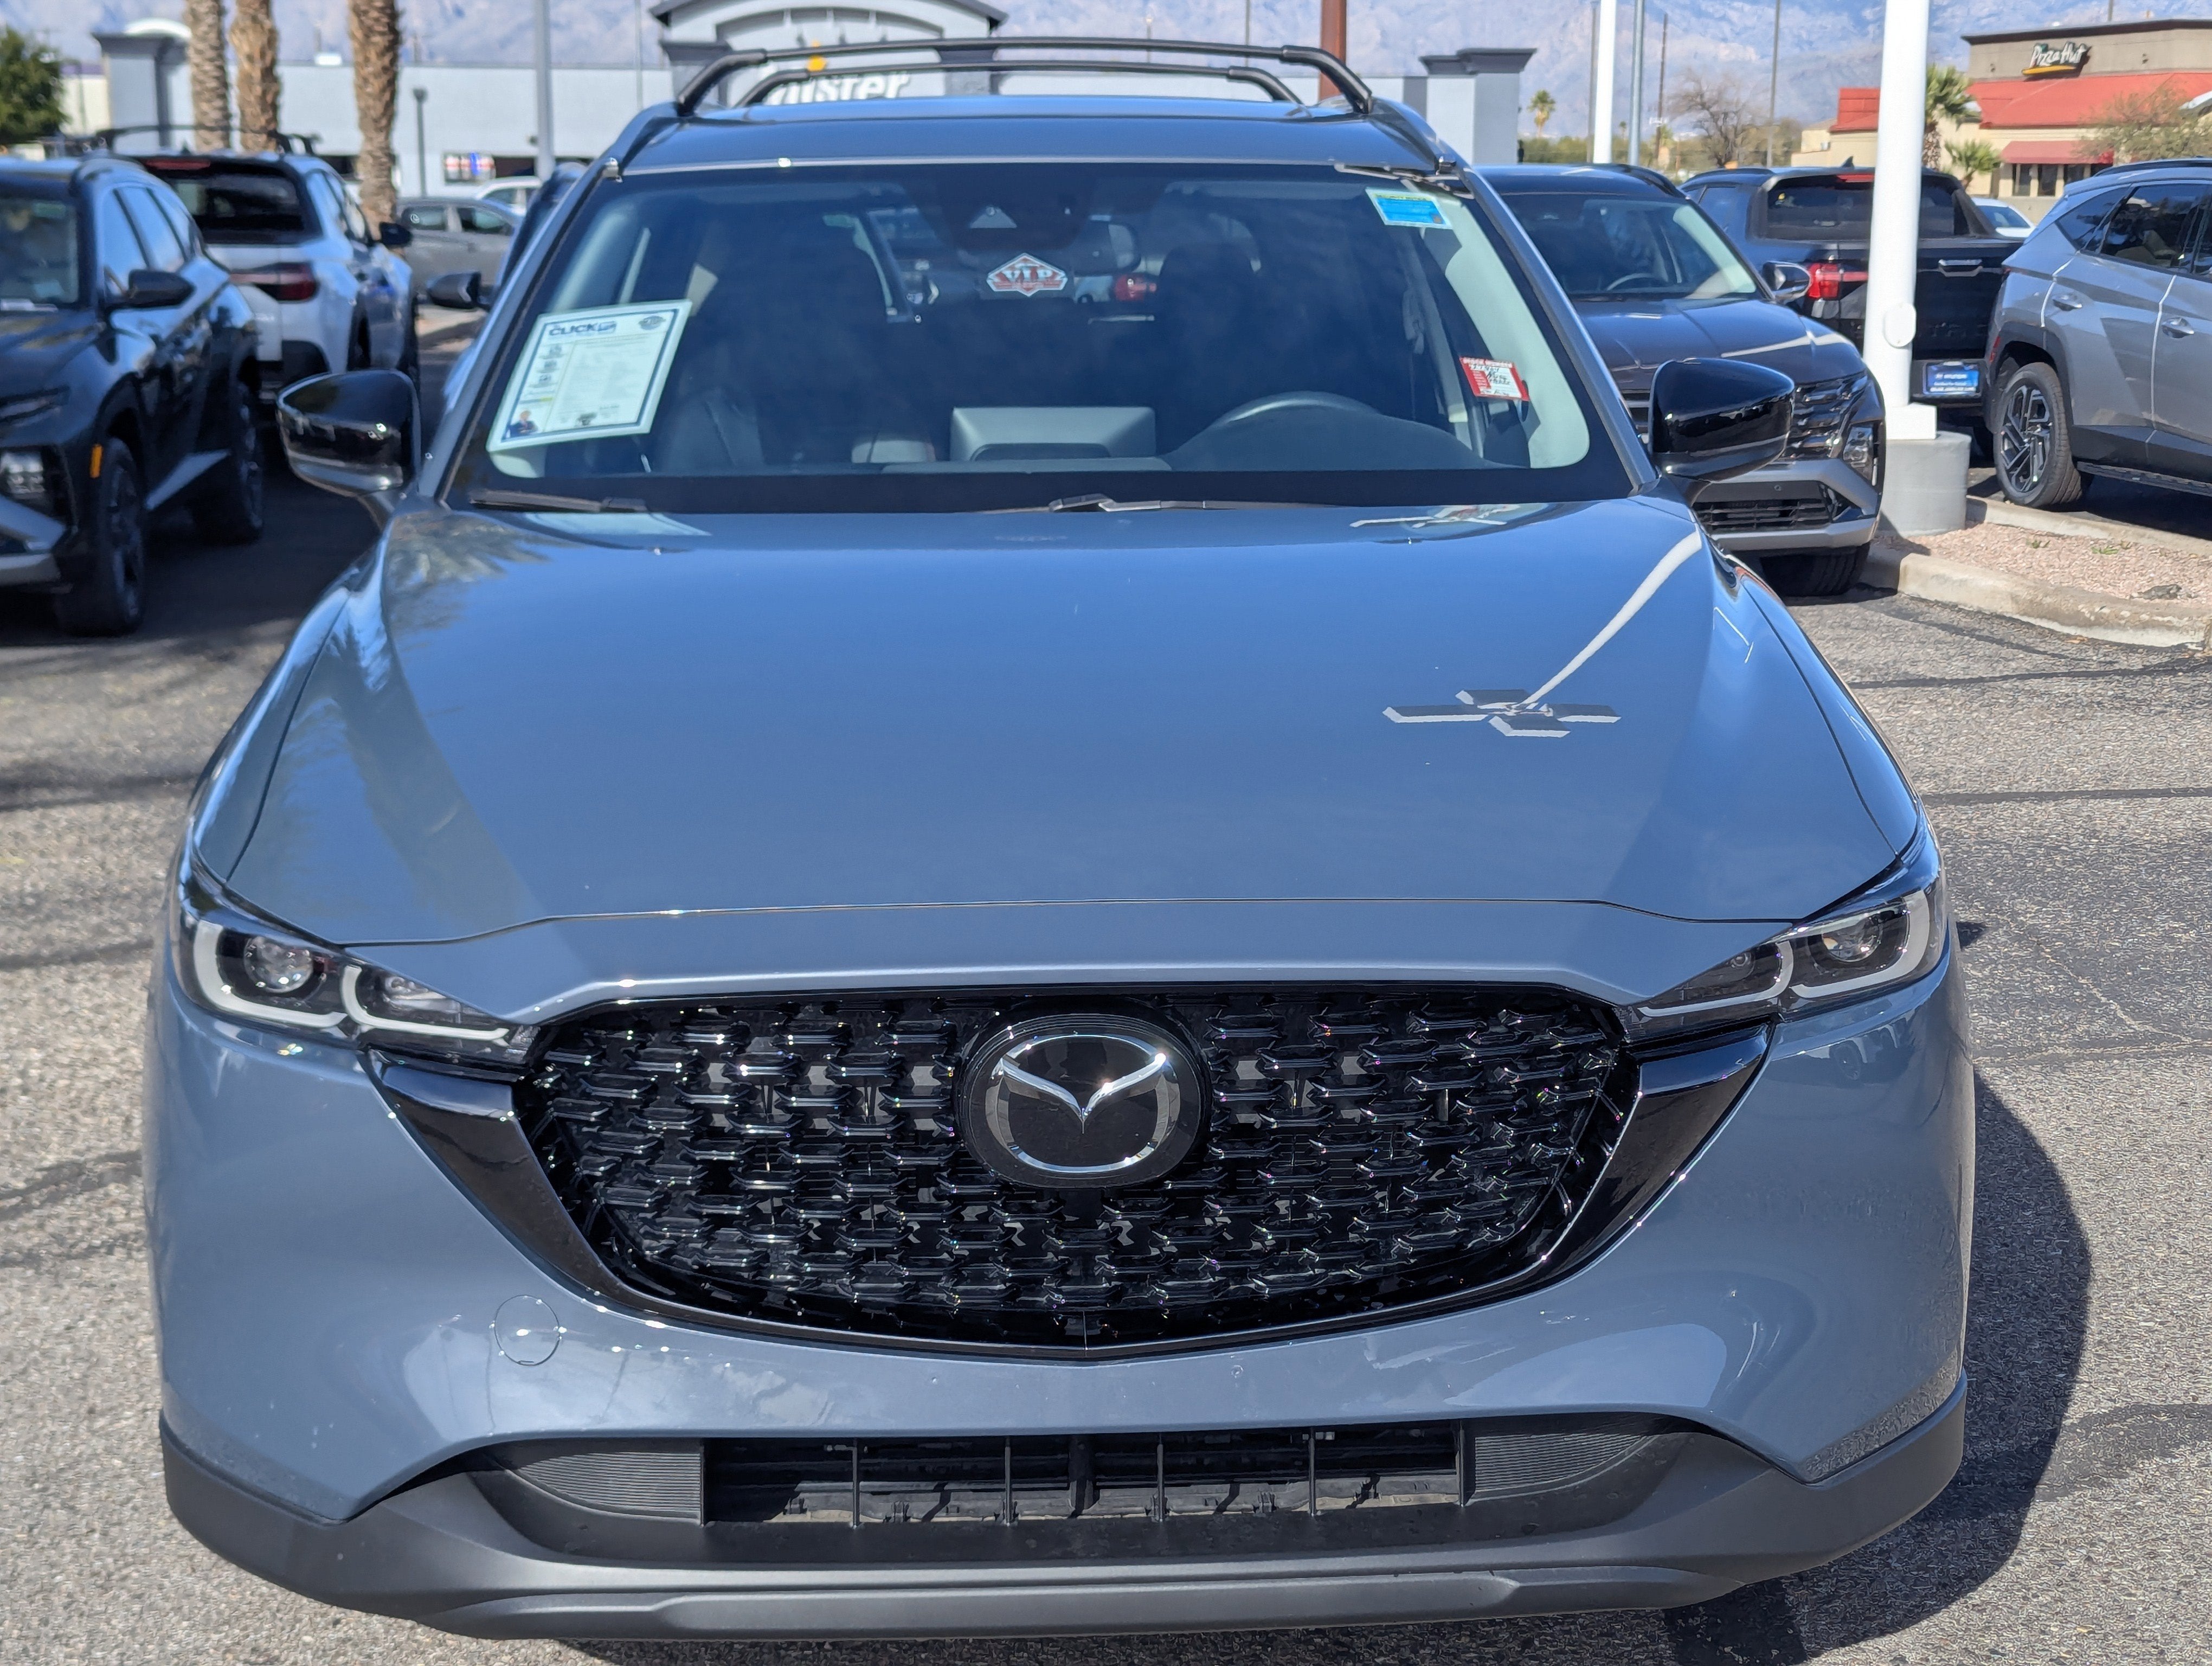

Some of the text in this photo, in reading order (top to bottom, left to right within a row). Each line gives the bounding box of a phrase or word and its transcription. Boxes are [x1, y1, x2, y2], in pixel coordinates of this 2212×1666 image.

[2029, 43, 2087, 68] Pizza Hut
[1001, 267, 1052, 281] VIP
